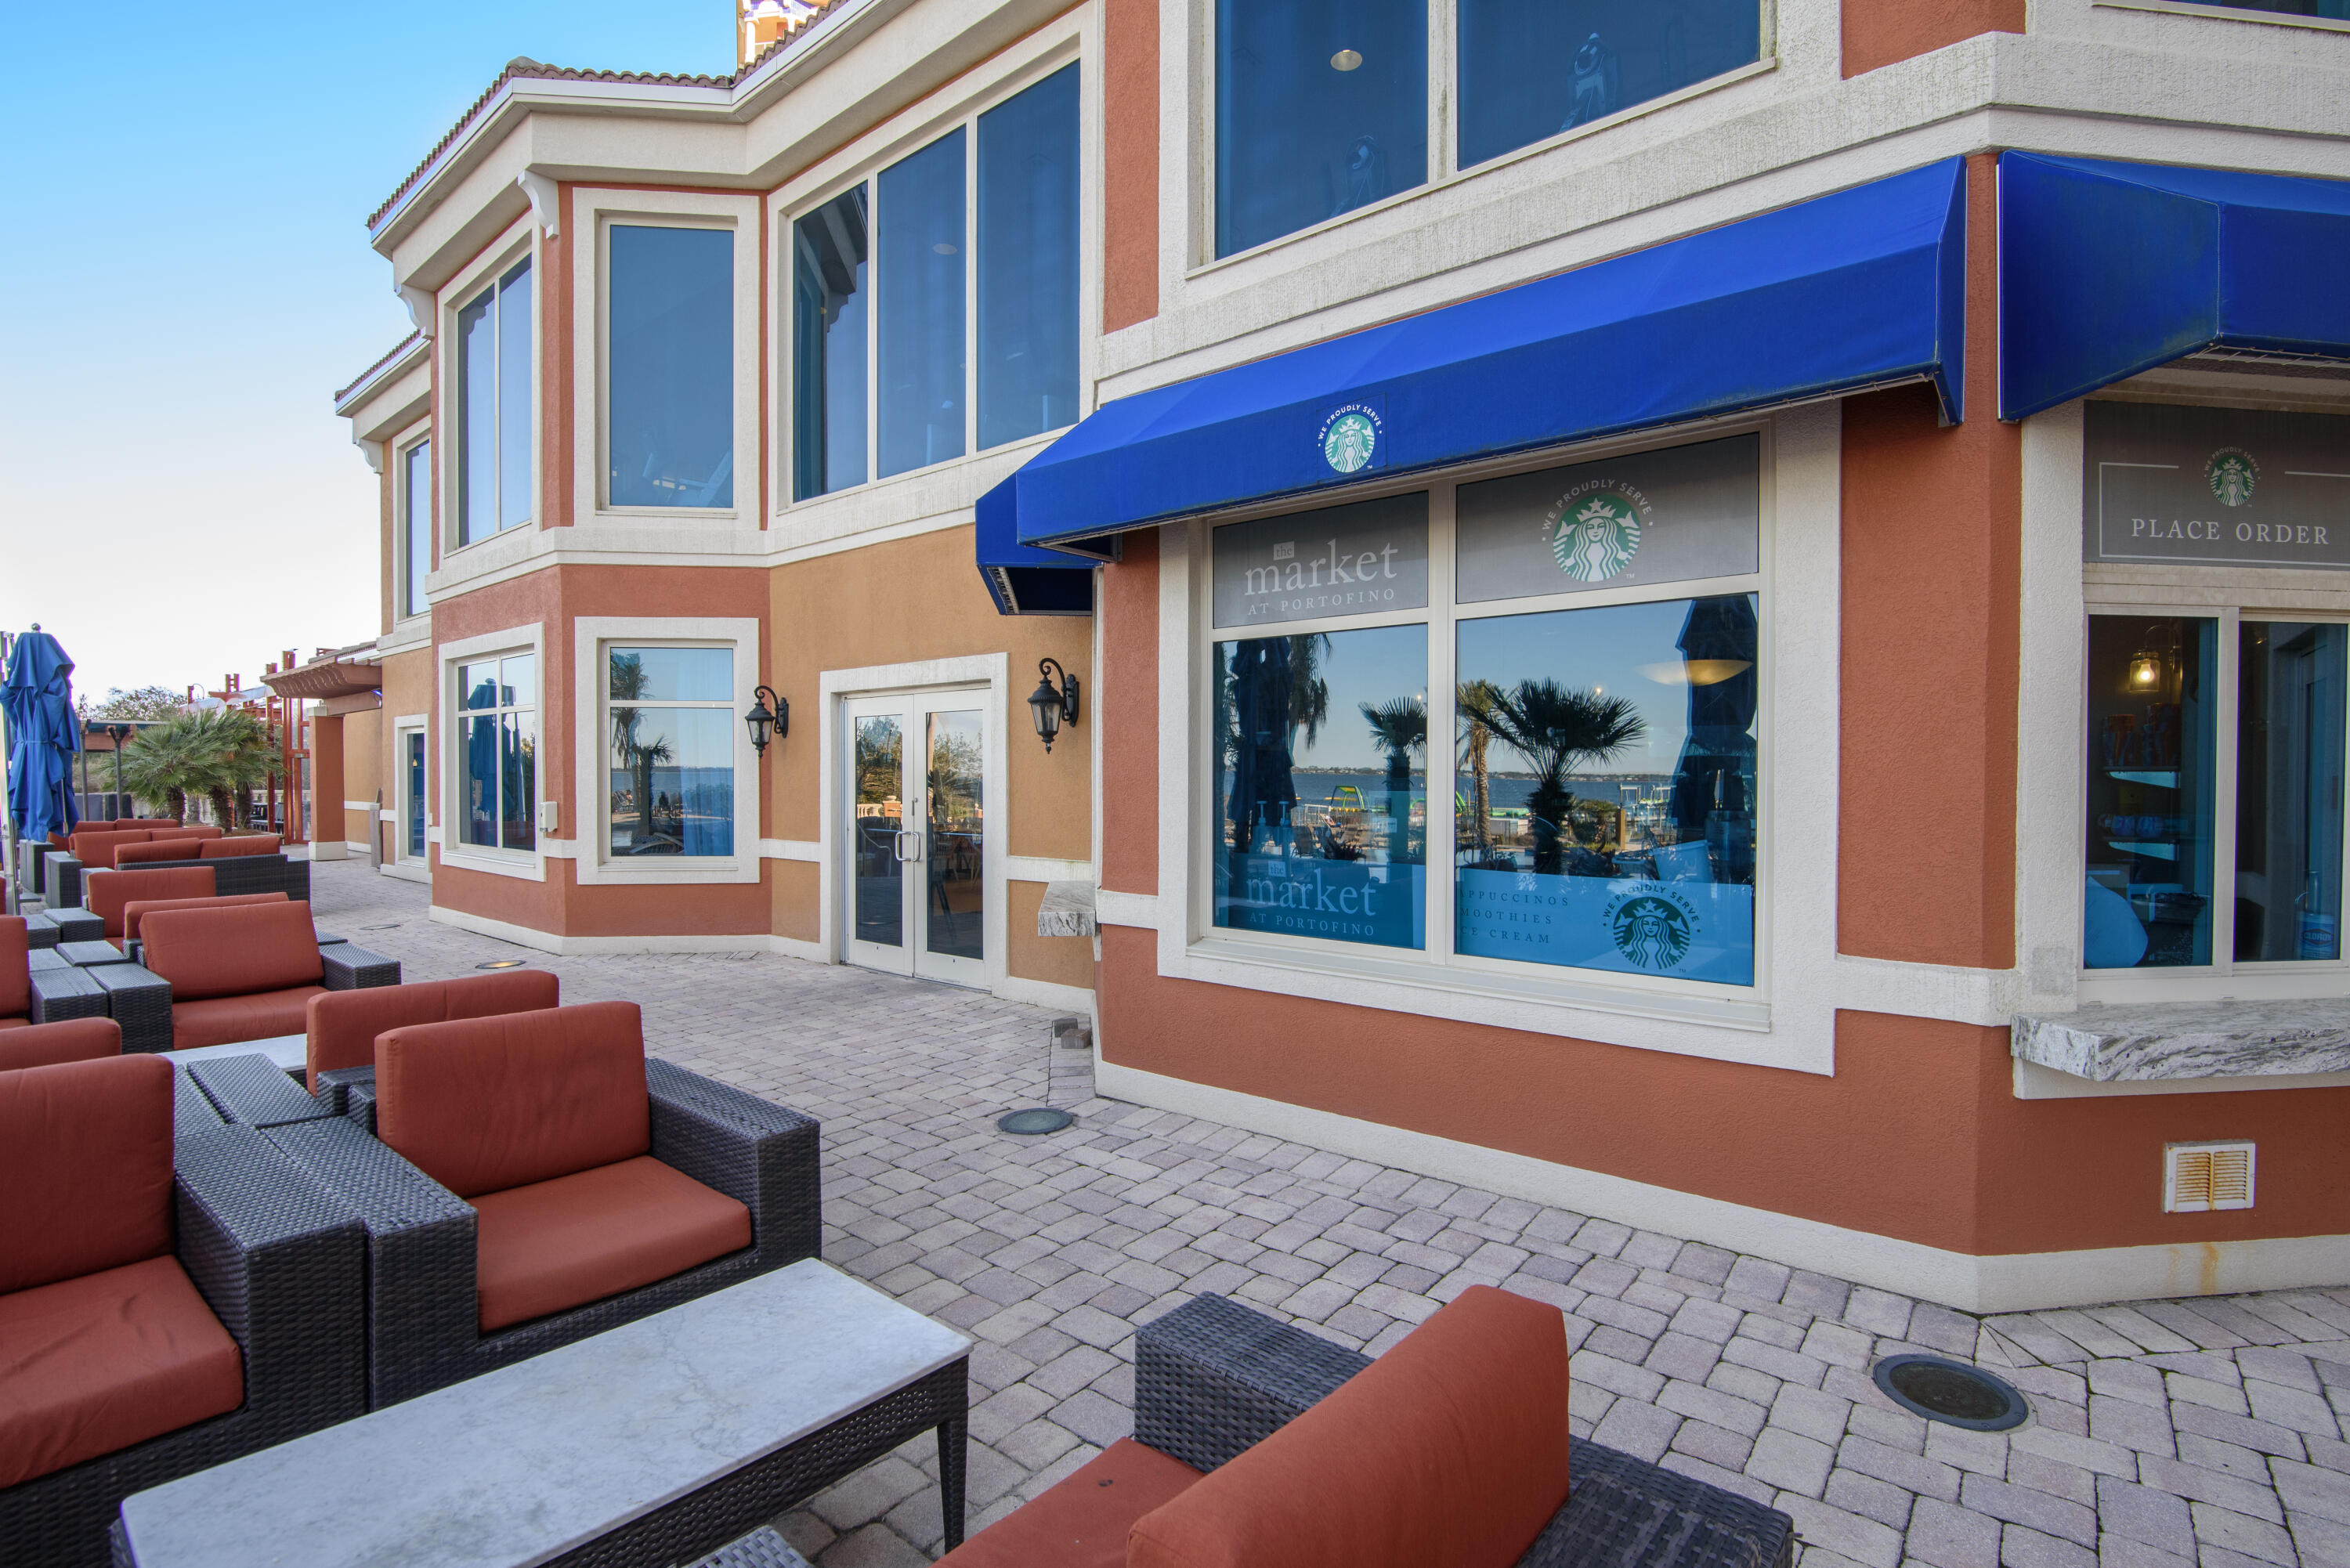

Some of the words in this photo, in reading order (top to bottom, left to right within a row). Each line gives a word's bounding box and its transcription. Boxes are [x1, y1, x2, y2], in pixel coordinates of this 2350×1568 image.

[1318, 427, 1327, 439] WE
[1326, 404, 1361, 425] PROUDLY
[1362, 406, 1382, 427] SERVE
[1542, 511, 1556, 530] WE
[1556, 479, 1615, 508] PROUDLY
[1618, 482, 1652, 515] SERVE
[2131, 518, 2221, 540] PLACE
[2236, 522, 2330, 545] ORDER
[1276, 544, 1292, 558] the
[1244, 538, 1398, 596] market
[1248, 602, 1269, 615] AT
[1281, 588, 1395, 612] PORTOFINO
[1271, 863, 1285, 876] the
[1246, 868, 1376, 916] market
[1603, 902, 1615, 918] WE
[1614, 884, 1667, 902] PROUDLY
[1669, 891, 1700, 923] SERVE
[1249, 913, 1267, 923] AT
[1276, 915, 1375, 936] PORTOFINO
[1489, 929, 1549, 944] CREAM
